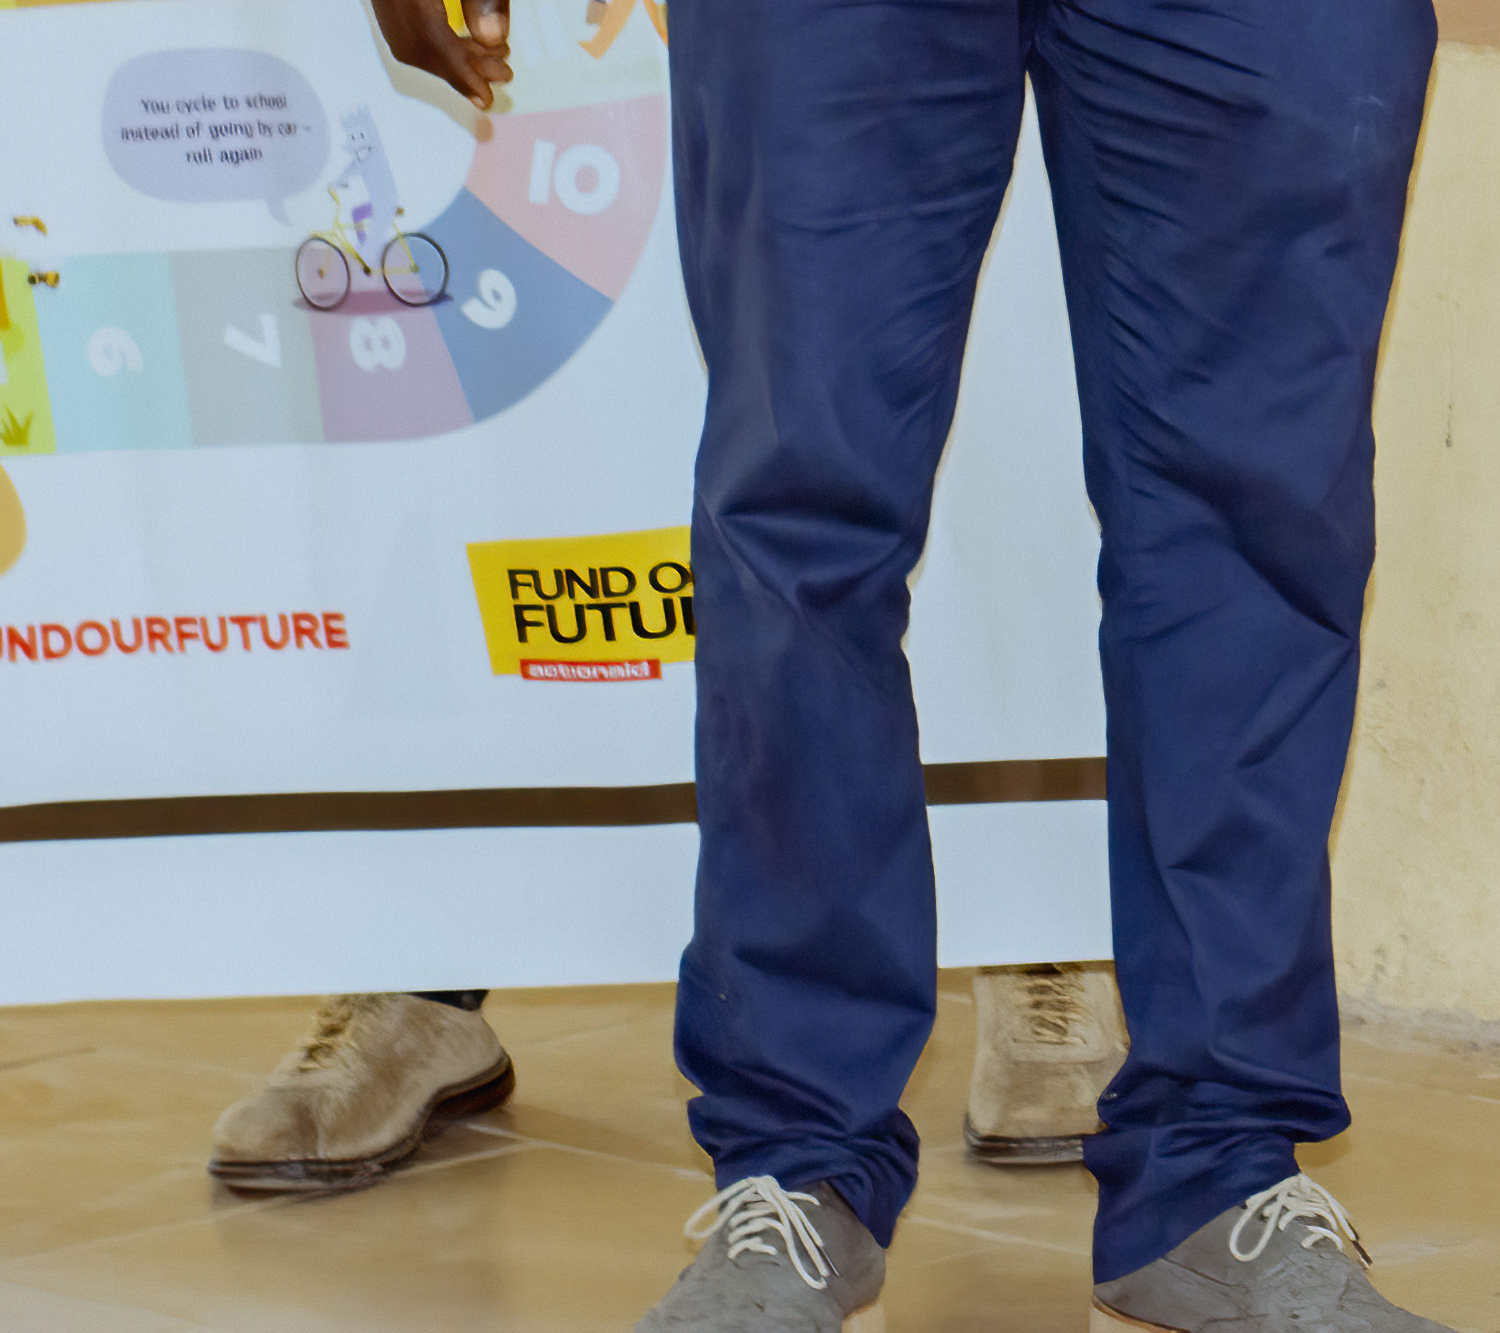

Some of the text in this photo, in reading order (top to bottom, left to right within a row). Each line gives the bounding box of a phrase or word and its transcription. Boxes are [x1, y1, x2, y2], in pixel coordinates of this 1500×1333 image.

[141, 92, 288, 115] You cycle to school
[121, 122, 181, 142] instead
[185, 120, 202, 139] of
[208, 120, 254, 141] going
[257, 118, 274, 137] by
[277, 120, 298, 136] car
[186, 146, 263, 167] roll again
[528, 137, 620, 215] 10
[224, 314, 283, 370] 7
[349, 316, 407, 374] 8
[507, 565, 637, 601] FUND
[0, 612, 349, 662] NDOURFUTURE
[513, 596, 696, 644] FUTU
